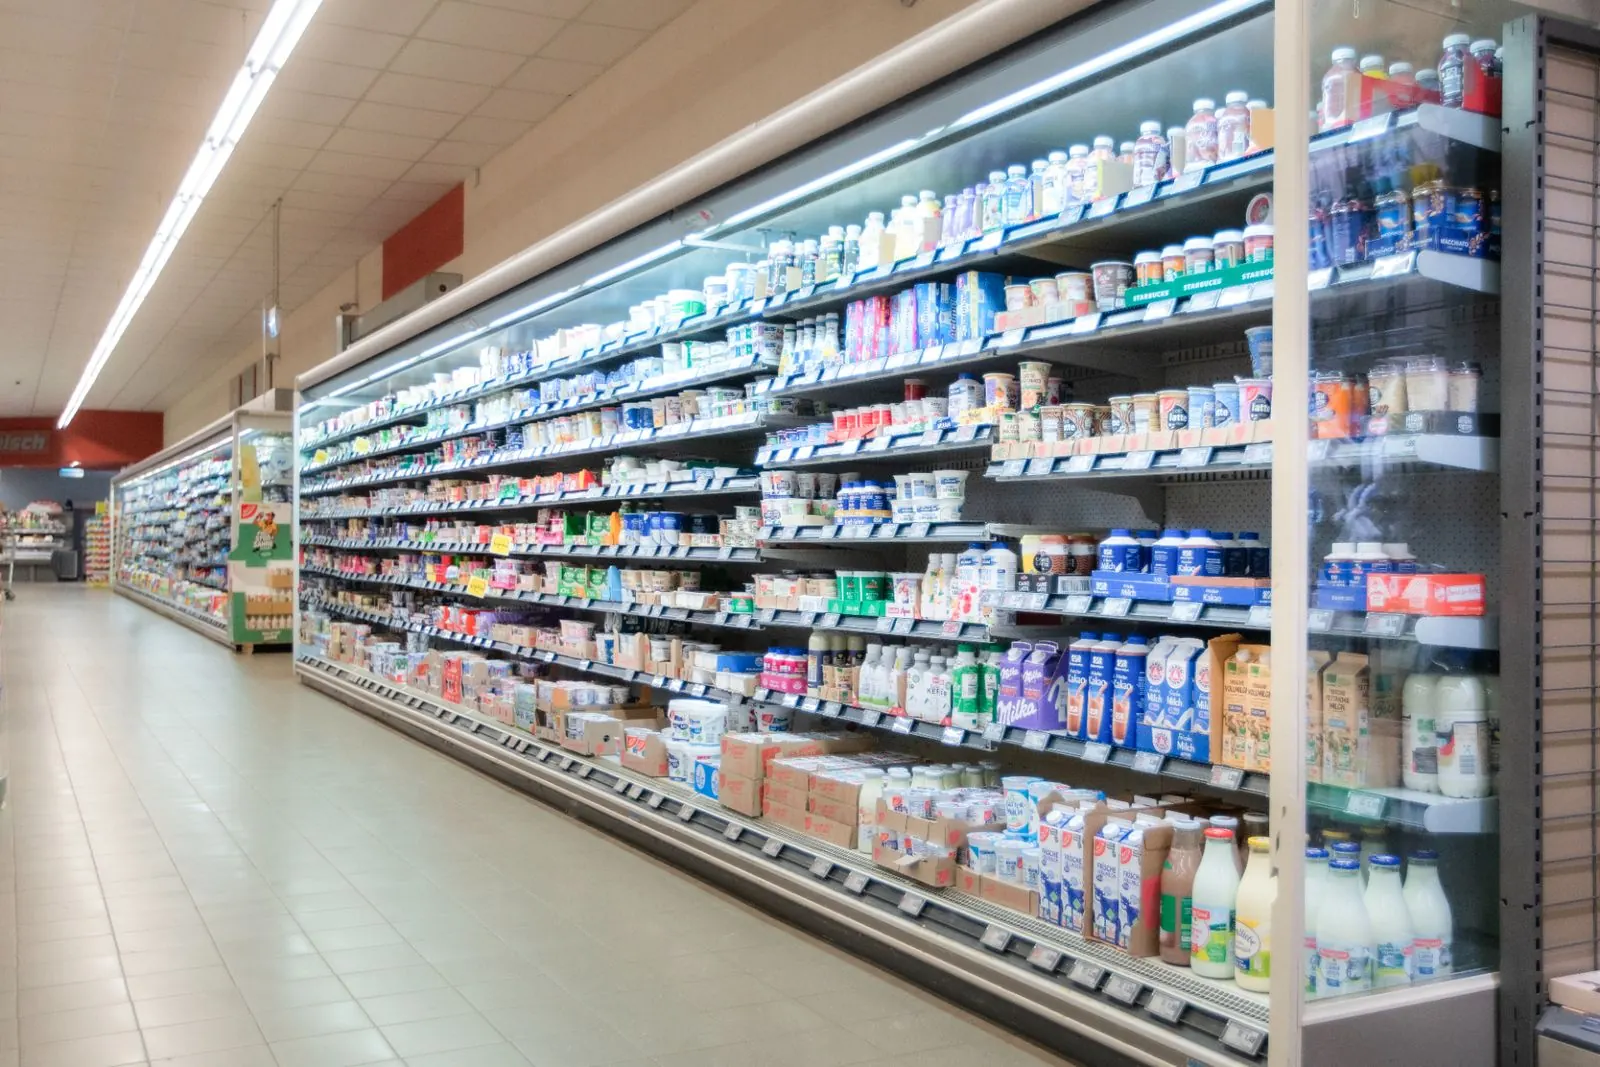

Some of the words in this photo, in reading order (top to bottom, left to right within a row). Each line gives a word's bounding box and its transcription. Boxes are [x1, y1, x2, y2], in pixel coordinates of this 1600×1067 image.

[1183, 277, 1222, 292] STARBUCKS
[1132, 289, 1170, 303] STARBUCKS
[1169, 412, 1188, 423] latte
[1001, 666, 1020, 680] Milka
[1023, 669, 1042, 684] Milka
[1166, 695, 1183, 708] Milch
[996, 698, 1038, 726] Milka
[1176, 740, 1196, 754] Milch
